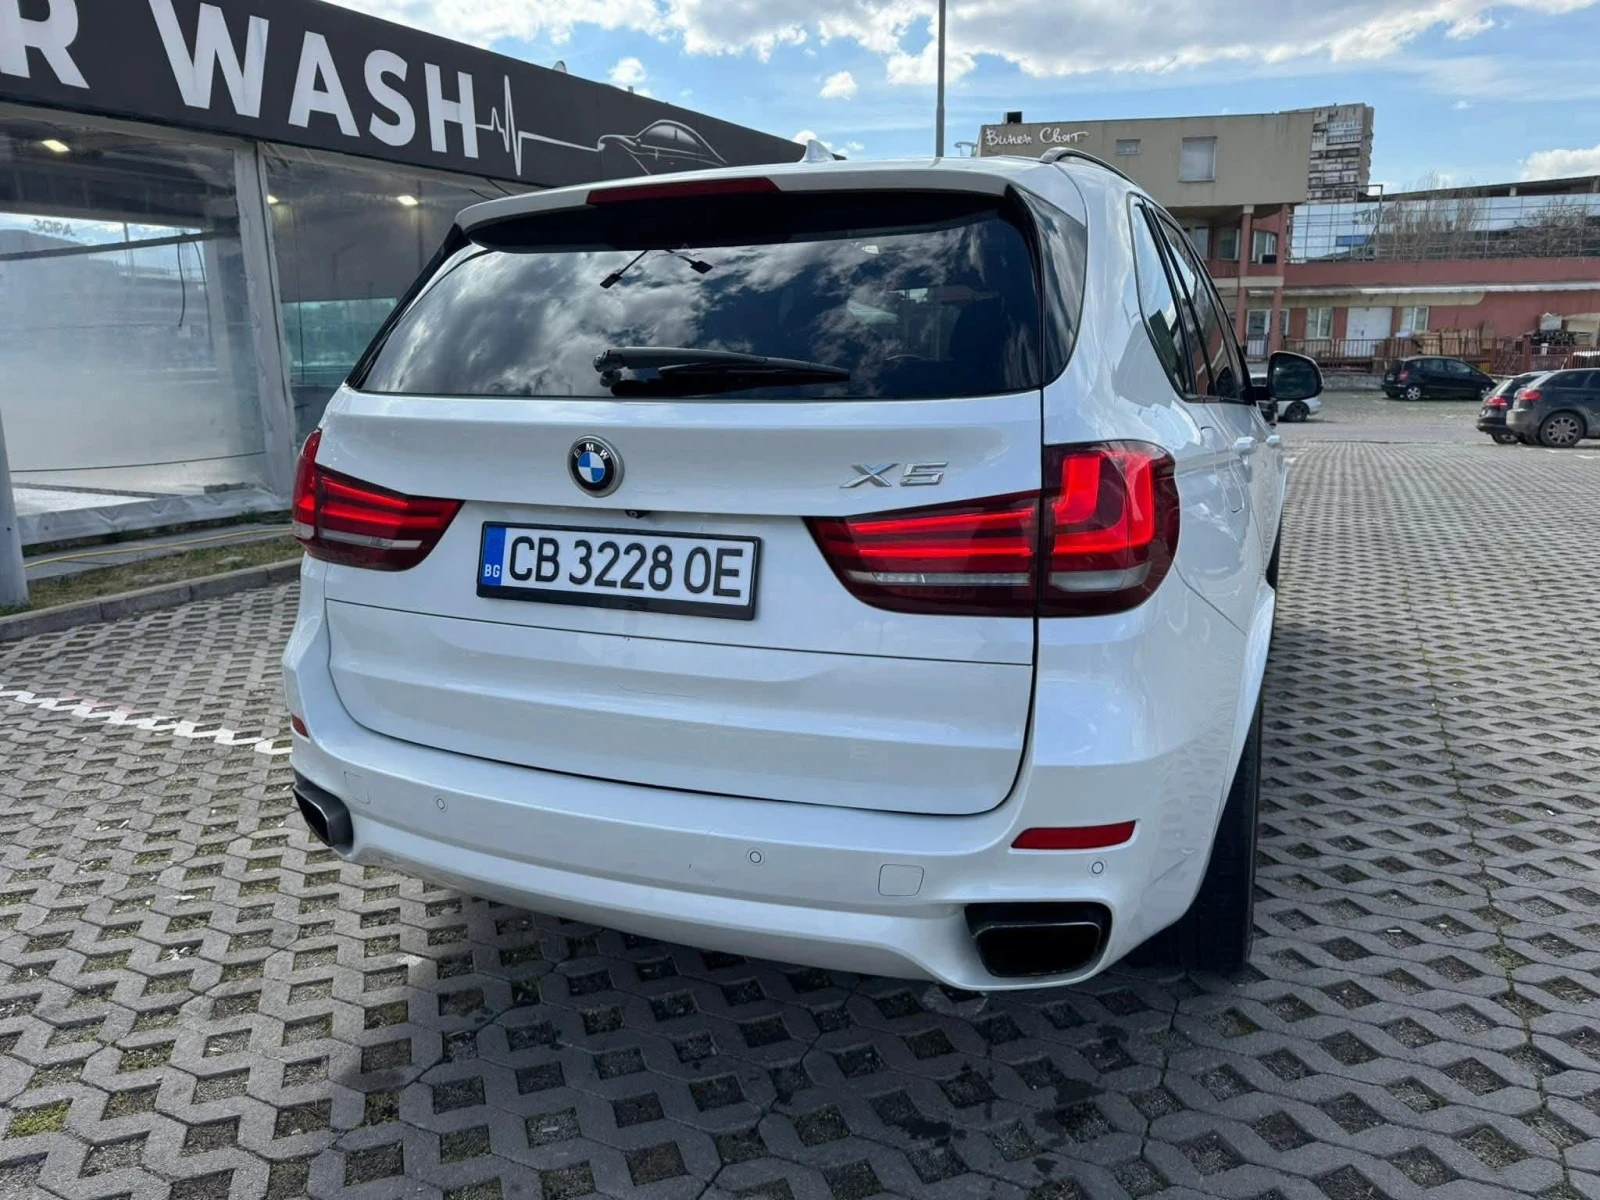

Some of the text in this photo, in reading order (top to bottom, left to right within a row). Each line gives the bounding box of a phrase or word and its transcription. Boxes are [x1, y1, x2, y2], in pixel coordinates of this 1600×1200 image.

[149, 0, 479, 159] WASH
[985, 127, 1089, 147] Винен Свят
[573, 443, 610, 460] BMW
[839, 461, 949, 488] X5
[484, 564, 501, 578] BG
[509, 536, 744, 598] CB 3228 OE
